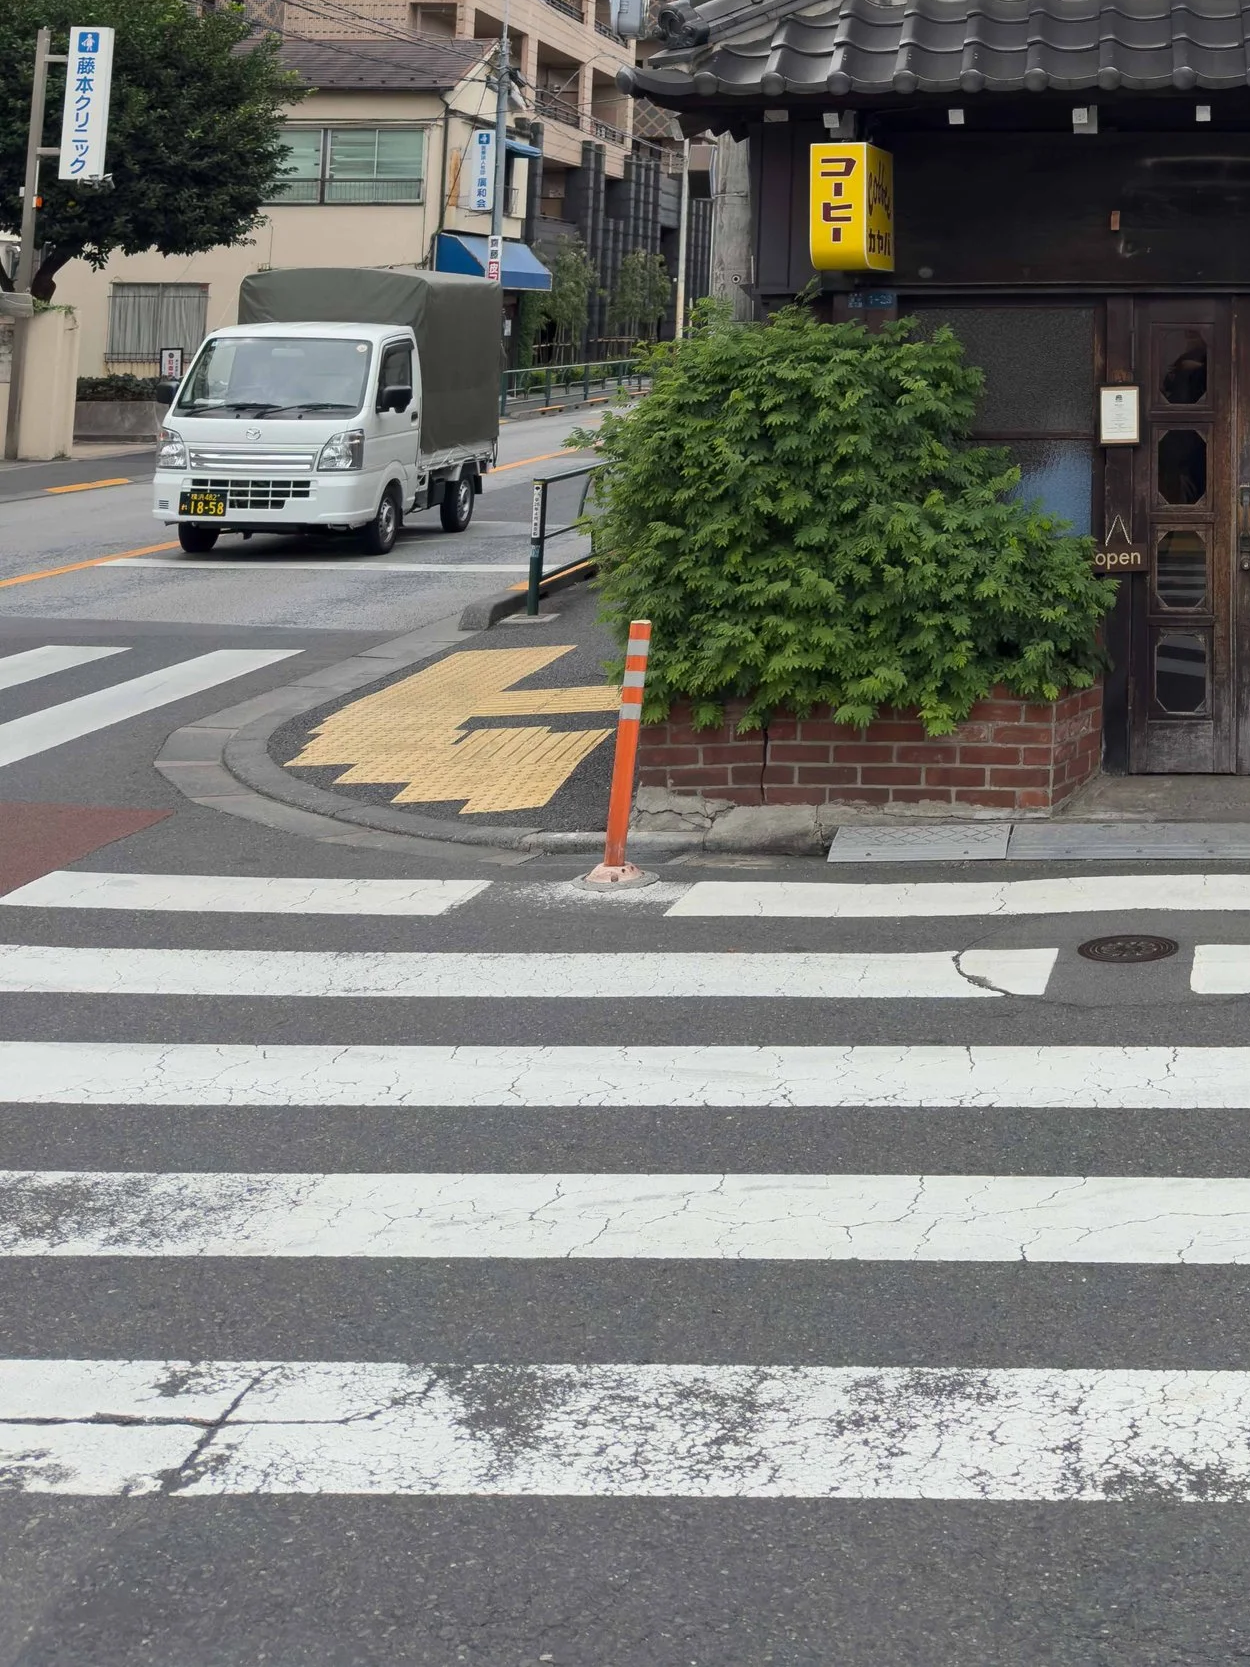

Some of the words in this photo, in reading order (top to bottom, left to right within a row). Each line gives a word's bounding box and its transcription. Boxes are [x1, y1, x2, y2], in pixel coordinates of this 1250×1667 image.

[69, 56, 97, 175] 藤本クリニック
[820, 157, 857, 243] コーヒー
[867, 227, 892, 256] カヤバ
[190, 501, 225, 515] 18-58
[1095, 551, 1141, 570] open
